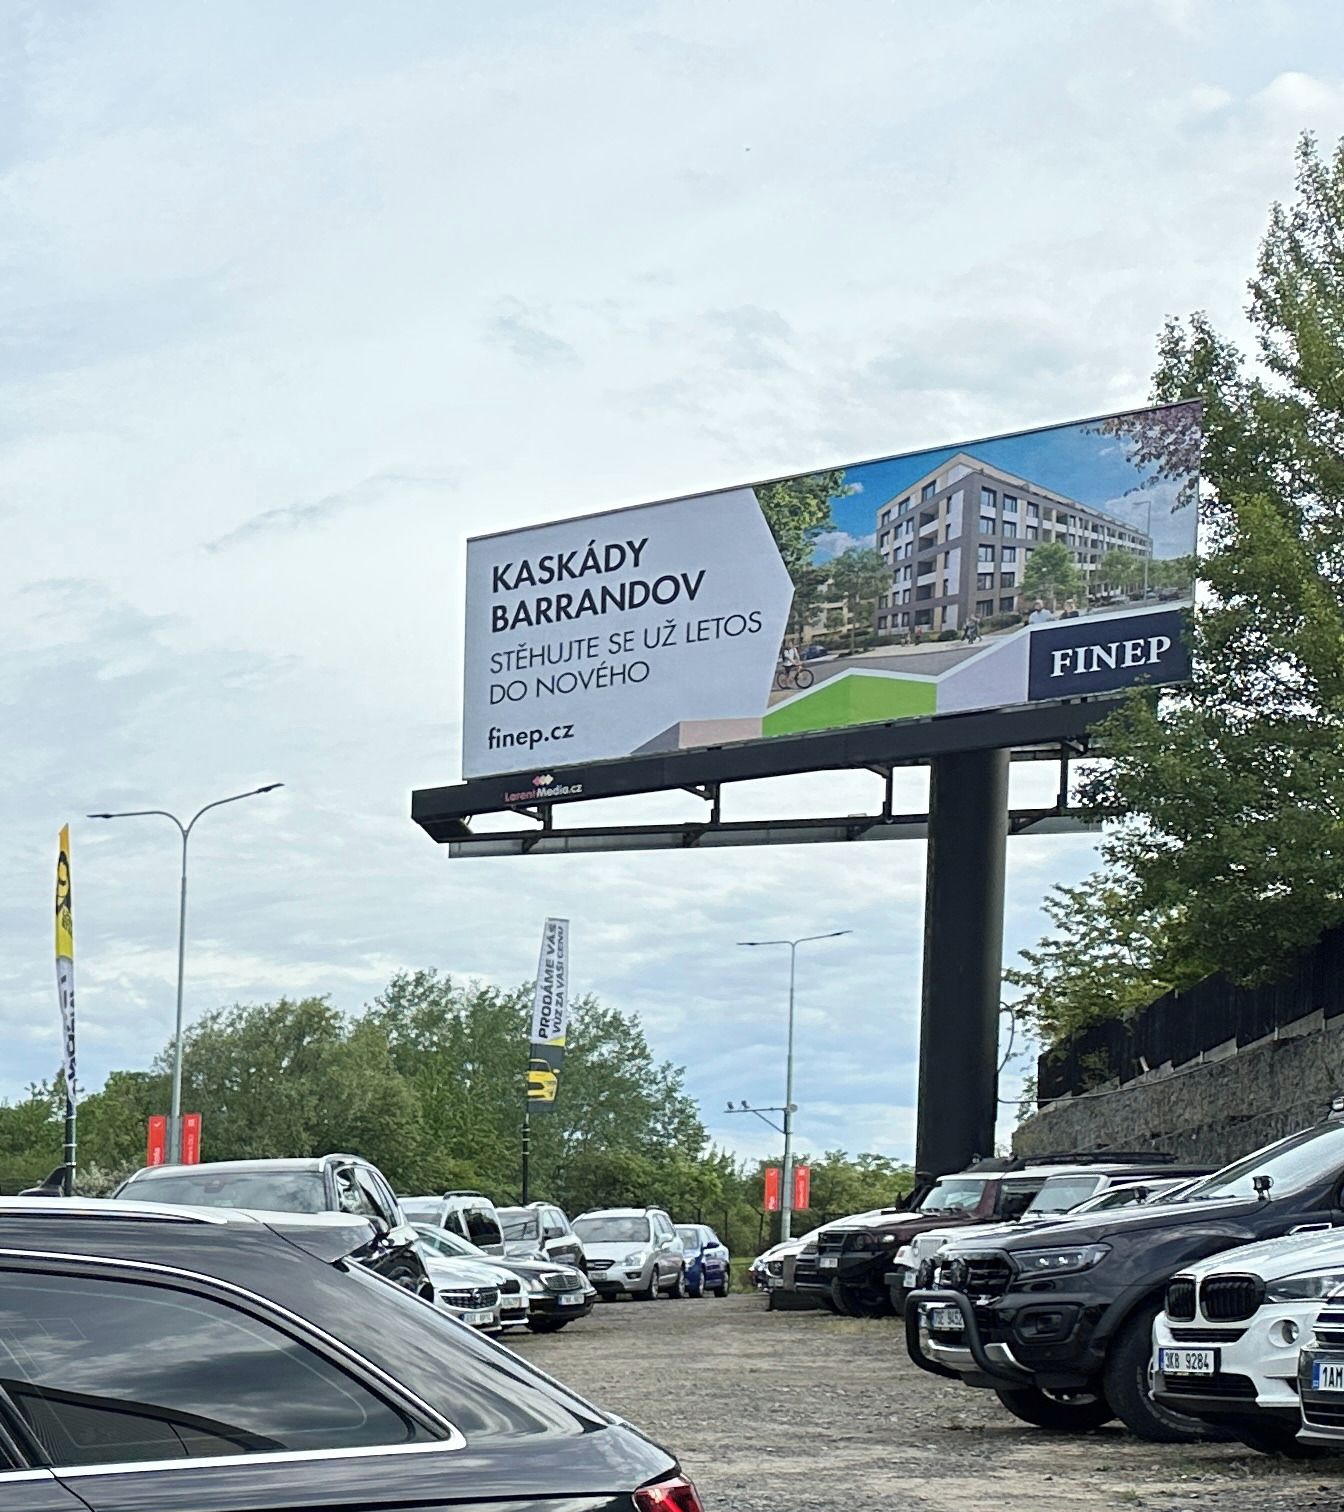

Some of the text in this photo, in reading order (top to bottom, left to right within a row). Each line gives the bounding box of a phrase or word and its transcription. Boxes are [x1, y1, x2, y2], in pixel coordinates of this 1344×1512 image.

[492, 538, 649, 593] KASKÁDY
[491, 569, 706, 633] BARRANDOV
[490, 611, 762, 674] STĚHUJTE SE UŽ LETOS
[1050, 635, 1172, 678] FINEP
[490, 660, 650, 705] DO NOVÉHO
[488, 724, 575, 750] finep.cz
[1185, 1353, 1210, 1371] 9284
